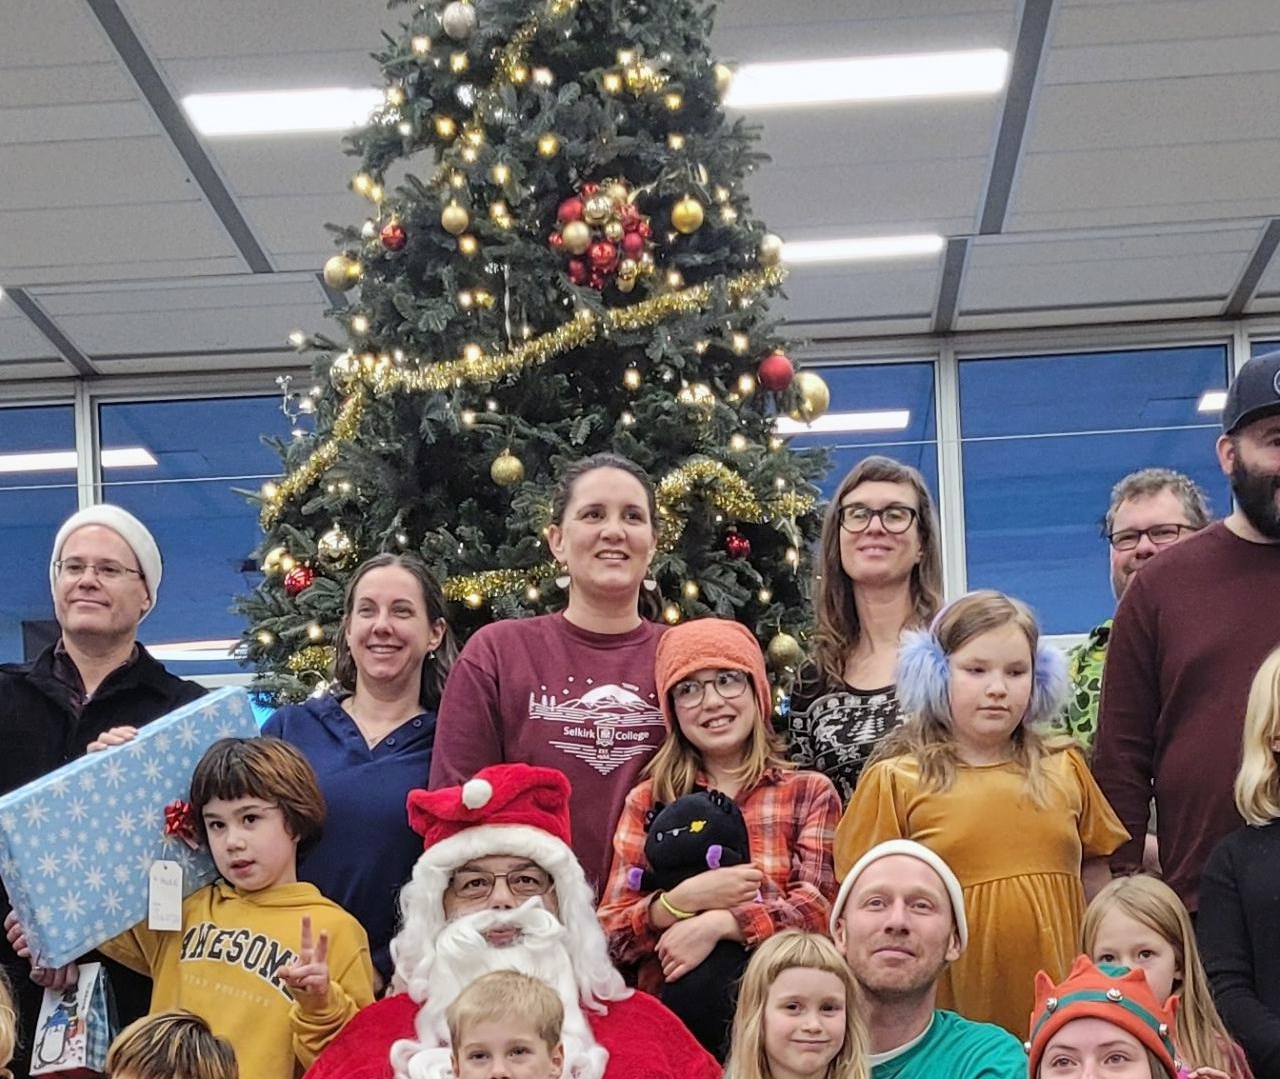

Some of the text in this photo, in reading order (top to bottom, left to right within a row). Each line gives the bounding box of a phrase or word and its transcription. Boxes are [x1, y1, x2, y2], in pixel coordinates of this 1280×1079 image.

[563, 726, 650, 742] Selkirk College
[180, 922, 299, 1001] AWESOM
